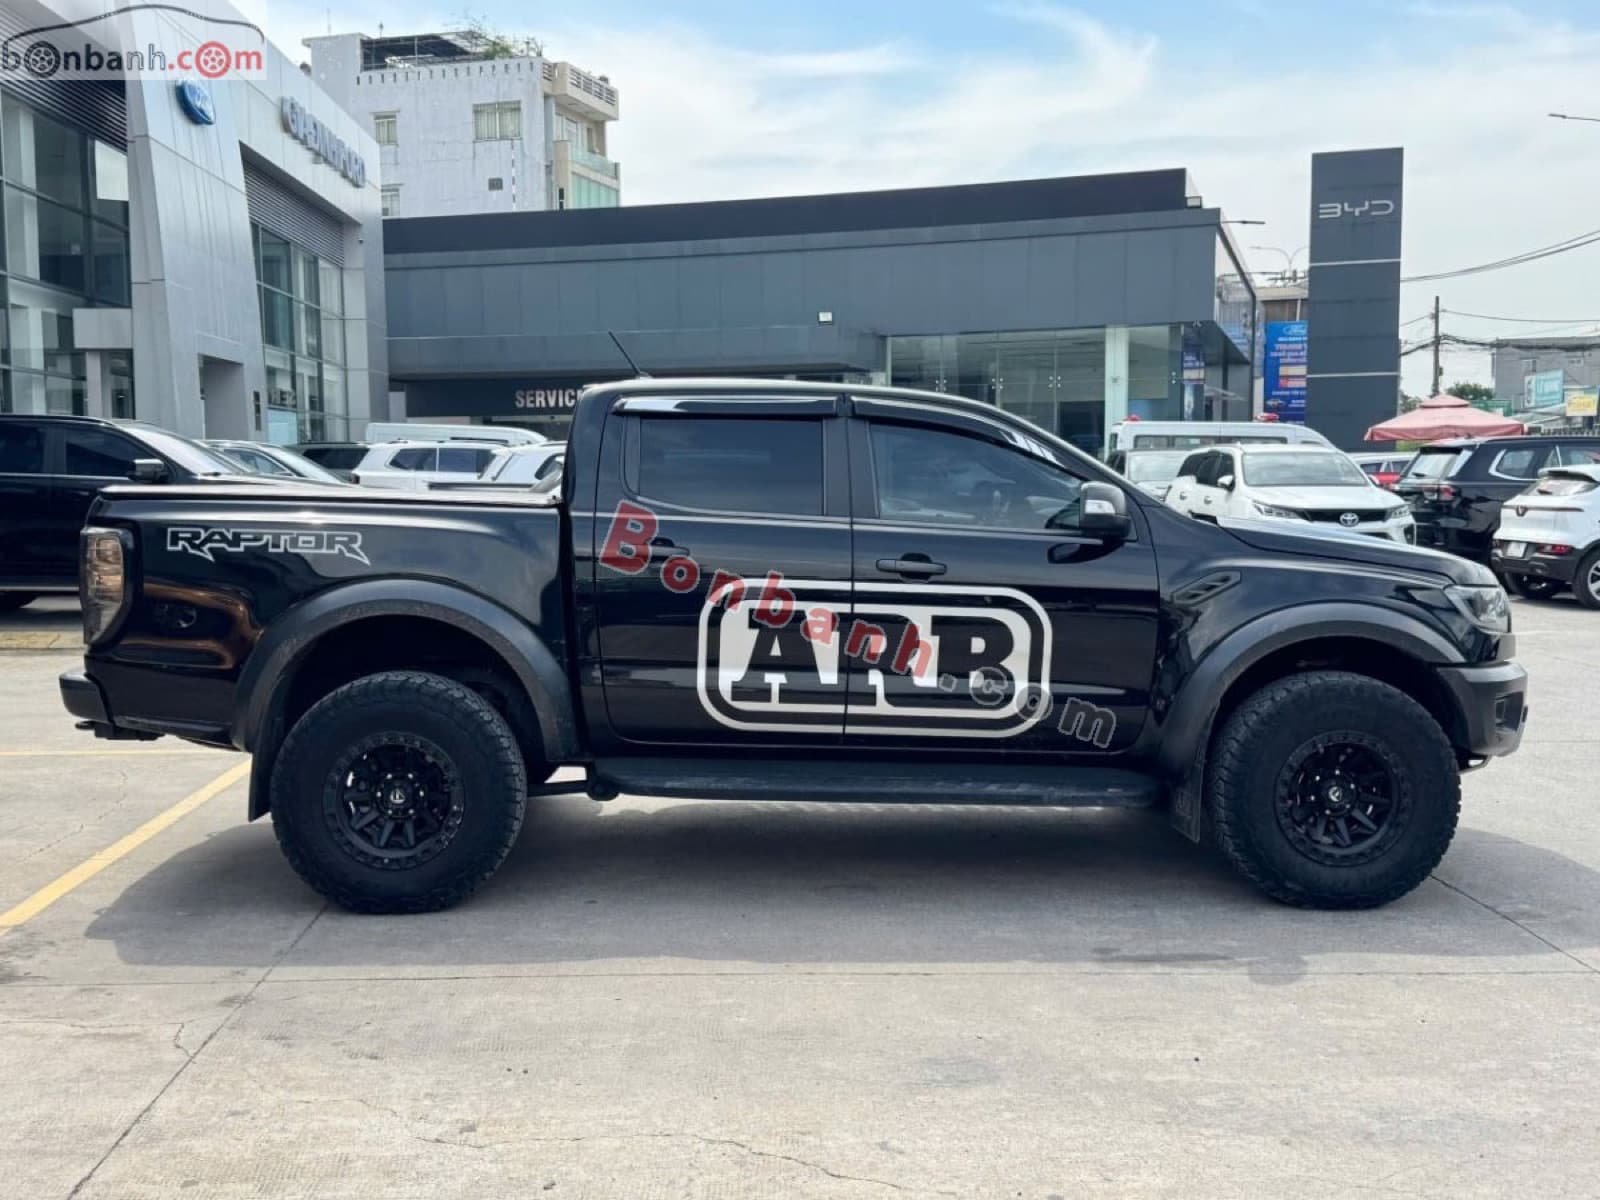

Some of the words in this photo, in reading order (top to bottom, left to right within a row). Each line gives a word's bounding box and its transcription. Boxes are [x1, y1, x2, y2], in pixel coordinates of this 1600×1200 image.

[1318, 200, 1394, 218] BYD
[167, 528, 371, 566] RAPTOR
[730, 607, 1016, 708] ARB
